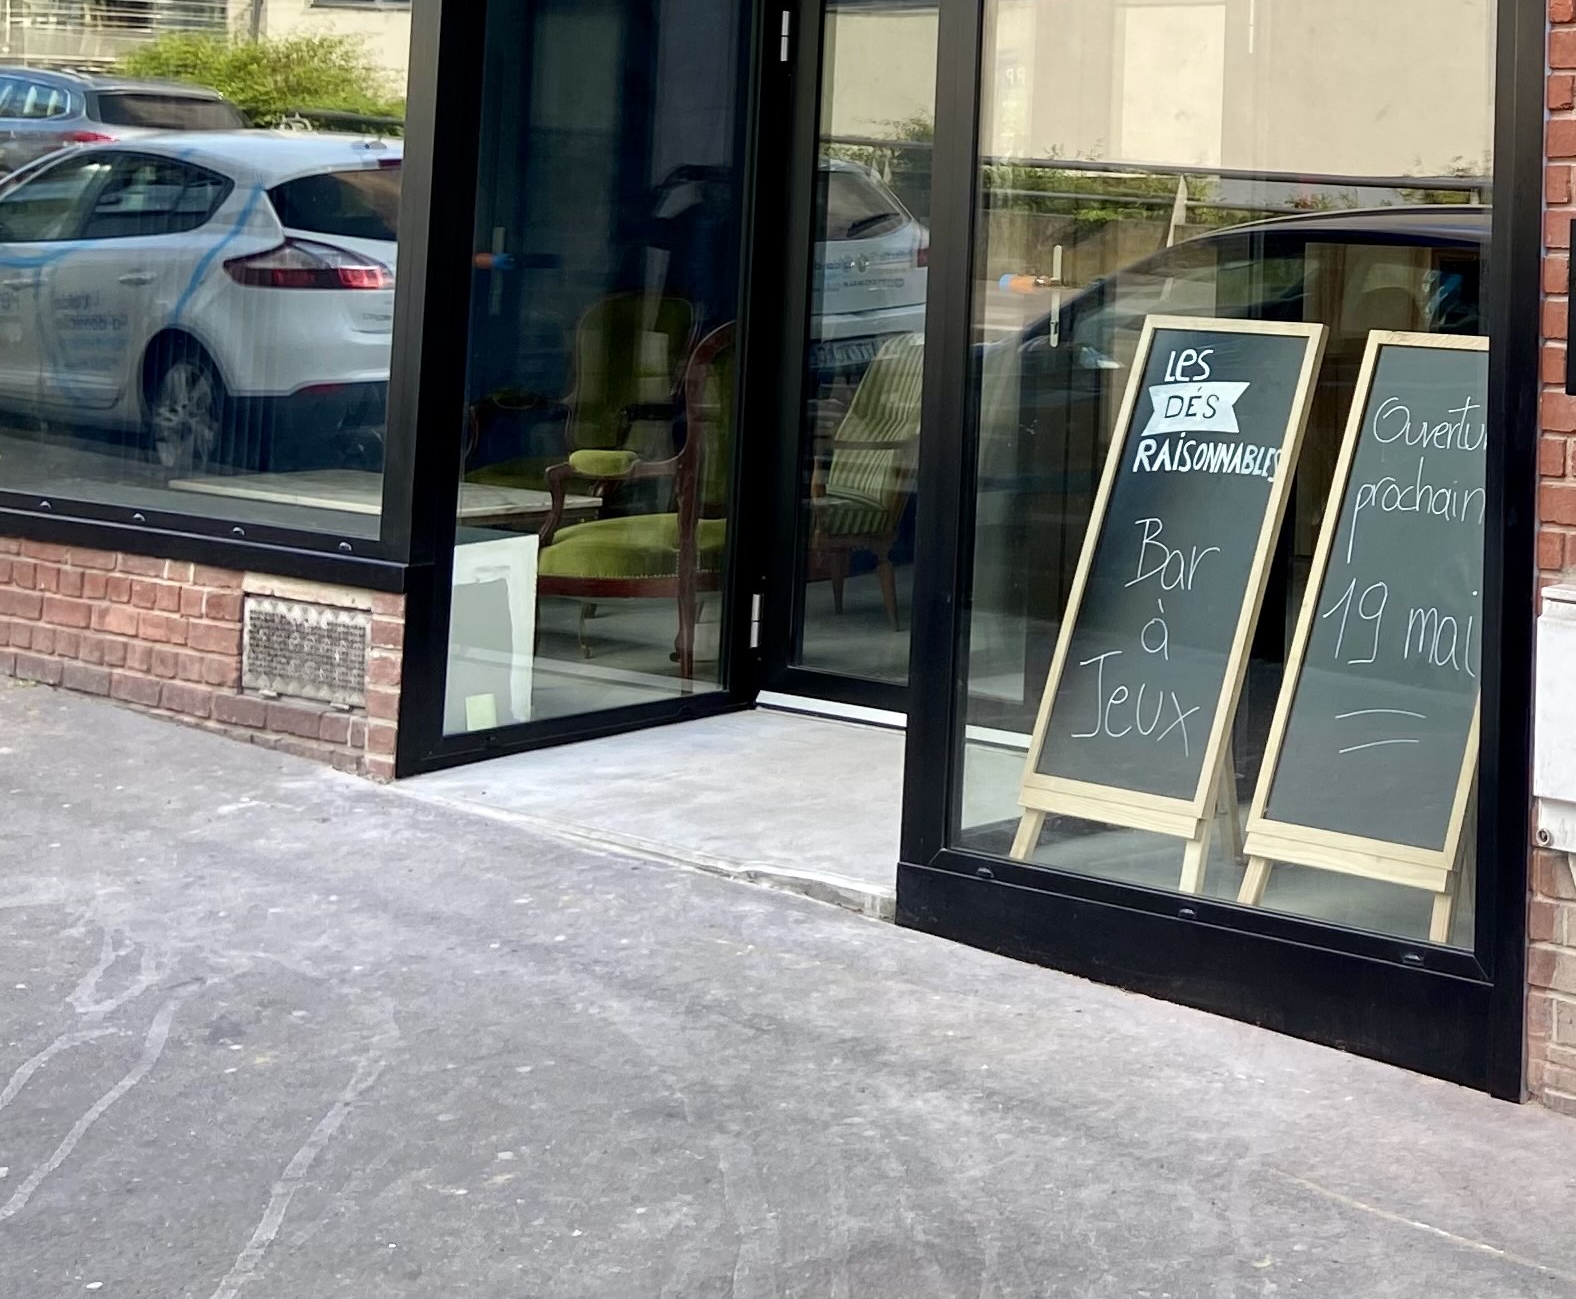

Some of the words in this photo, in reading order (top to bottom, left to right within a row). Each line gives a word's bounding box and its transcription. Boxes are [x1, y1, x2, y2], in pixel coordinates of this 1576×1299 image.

[1164, 386, 1220, 420] DÉS
[1124, 517, 1221, 593] Bar
[1140, 600, 1171, 661] à
[1322, 578, 1390, 666] 19
[1403, 590, 1479, 678] mai
[1070, 649, 1201, 757] Jeux
